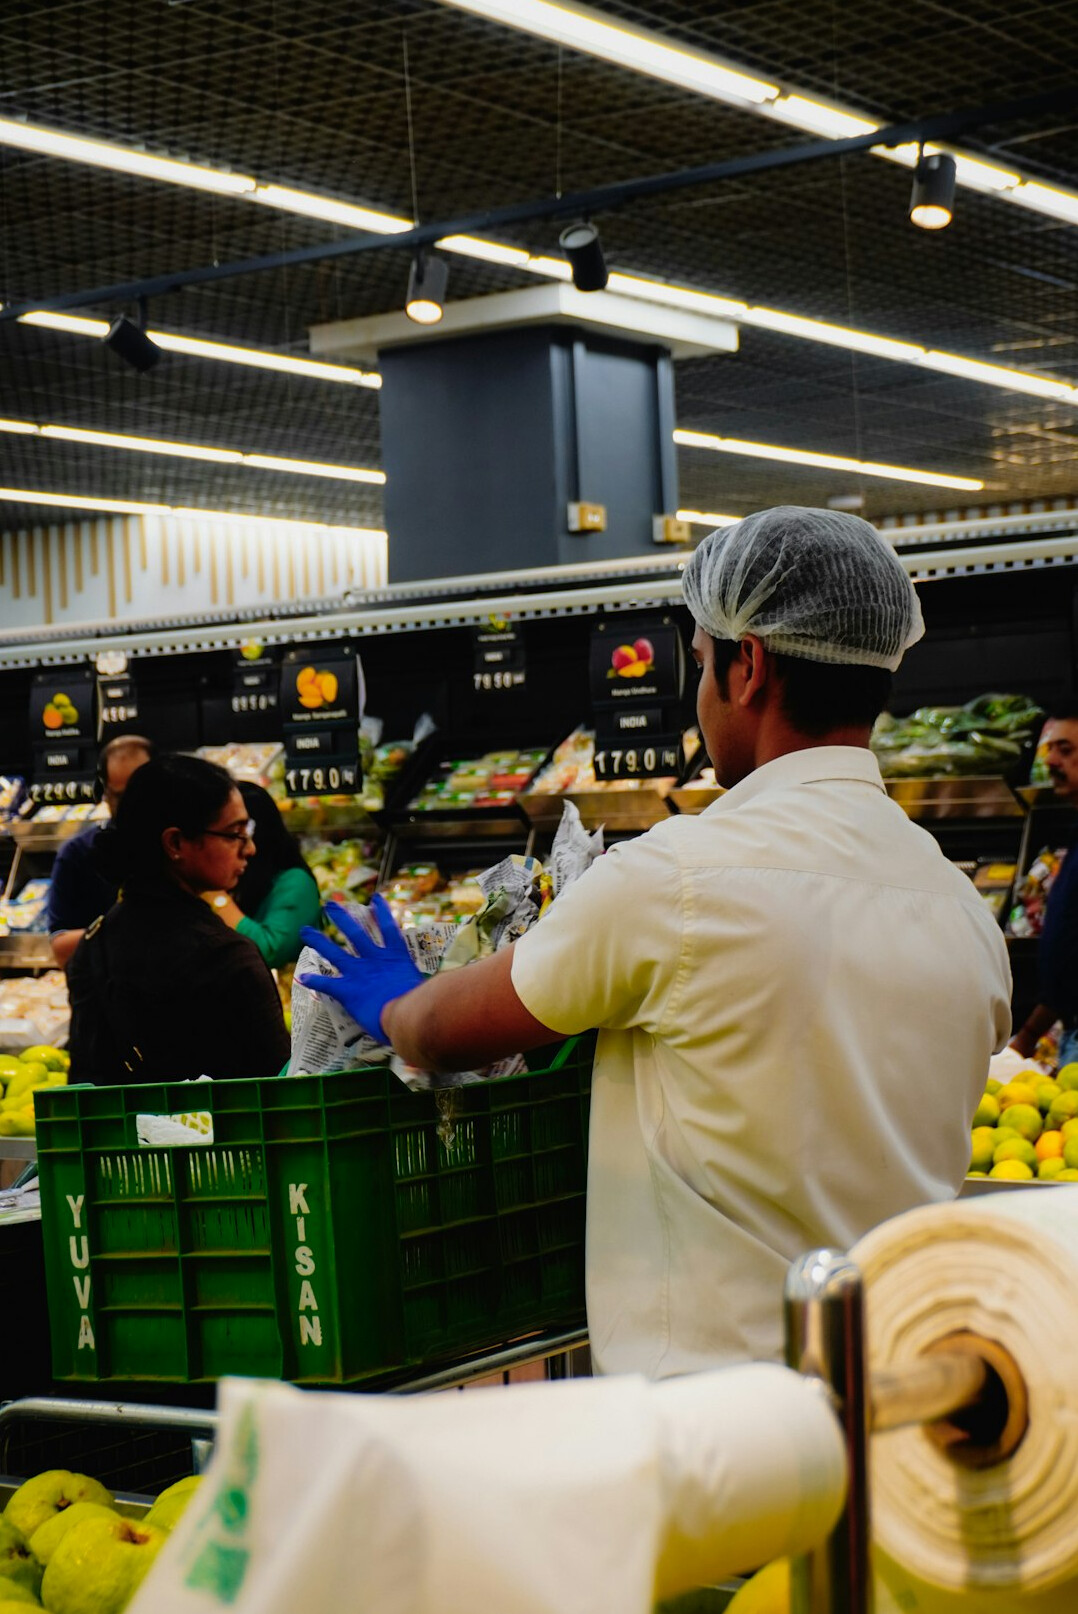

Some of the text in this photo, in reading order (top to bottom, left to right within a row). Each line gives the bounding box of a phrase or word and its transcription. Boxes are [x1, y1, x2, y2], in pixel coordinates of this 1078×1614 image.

[619, 714, 648, 729] INDIA
[295, 736, 321, 750] INDIA
[47, 754, 70, 767] INDIA
[65, 1194, 96, 1350] YUVA
[288, 1183, 323, 1347] KISAN
